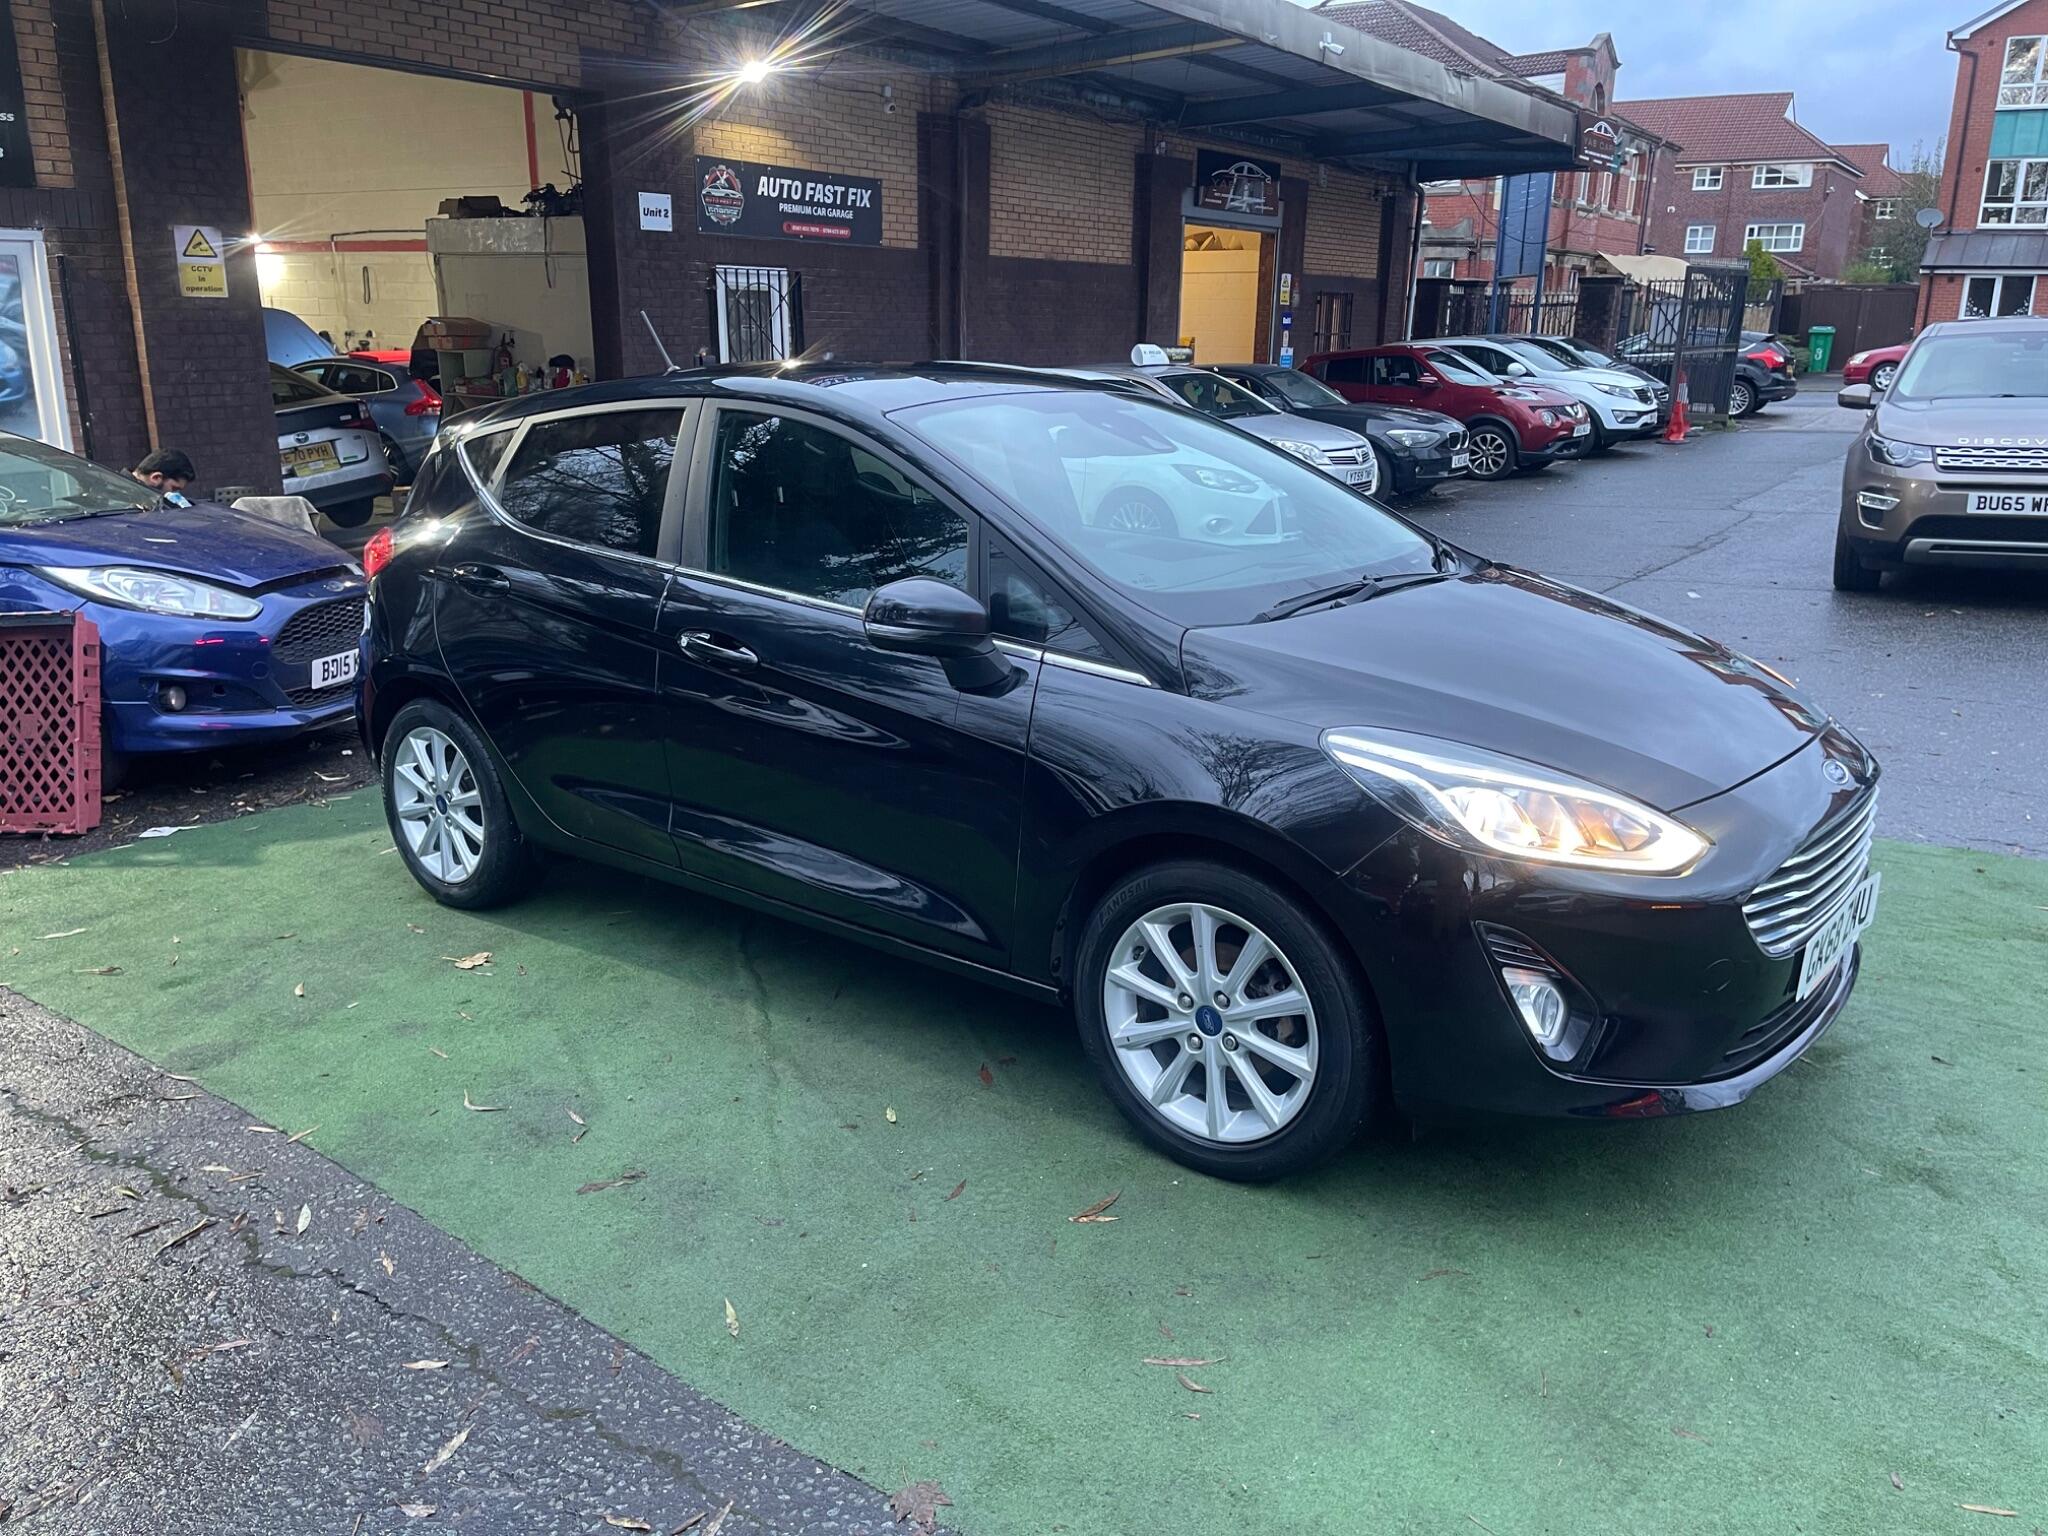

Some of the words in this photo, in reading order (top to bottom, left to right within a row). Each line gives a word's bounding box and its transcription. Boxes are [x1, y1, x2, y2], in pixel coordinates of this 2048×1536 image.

[757, 175, 802, 200] AUTO
[805, 181, 845, 205] FAST
[847, 187, 872, 208] FIX
[643, 207, 662, 218] Unit
[663, 208, 669, 218] 2
[779, 202, 811, 215] PREMIUM
[812, 206, 827, 217] CAR
[827, 208, 854, 219] GARAGE
[191, 265, 213, 273] CCTV
[307, 445, 329, 459] PYH
[1976, 495, 2026, 511] BU65
[322, 654, 351, 682] BD15
[1805, 911, 1845, 984] GK68
